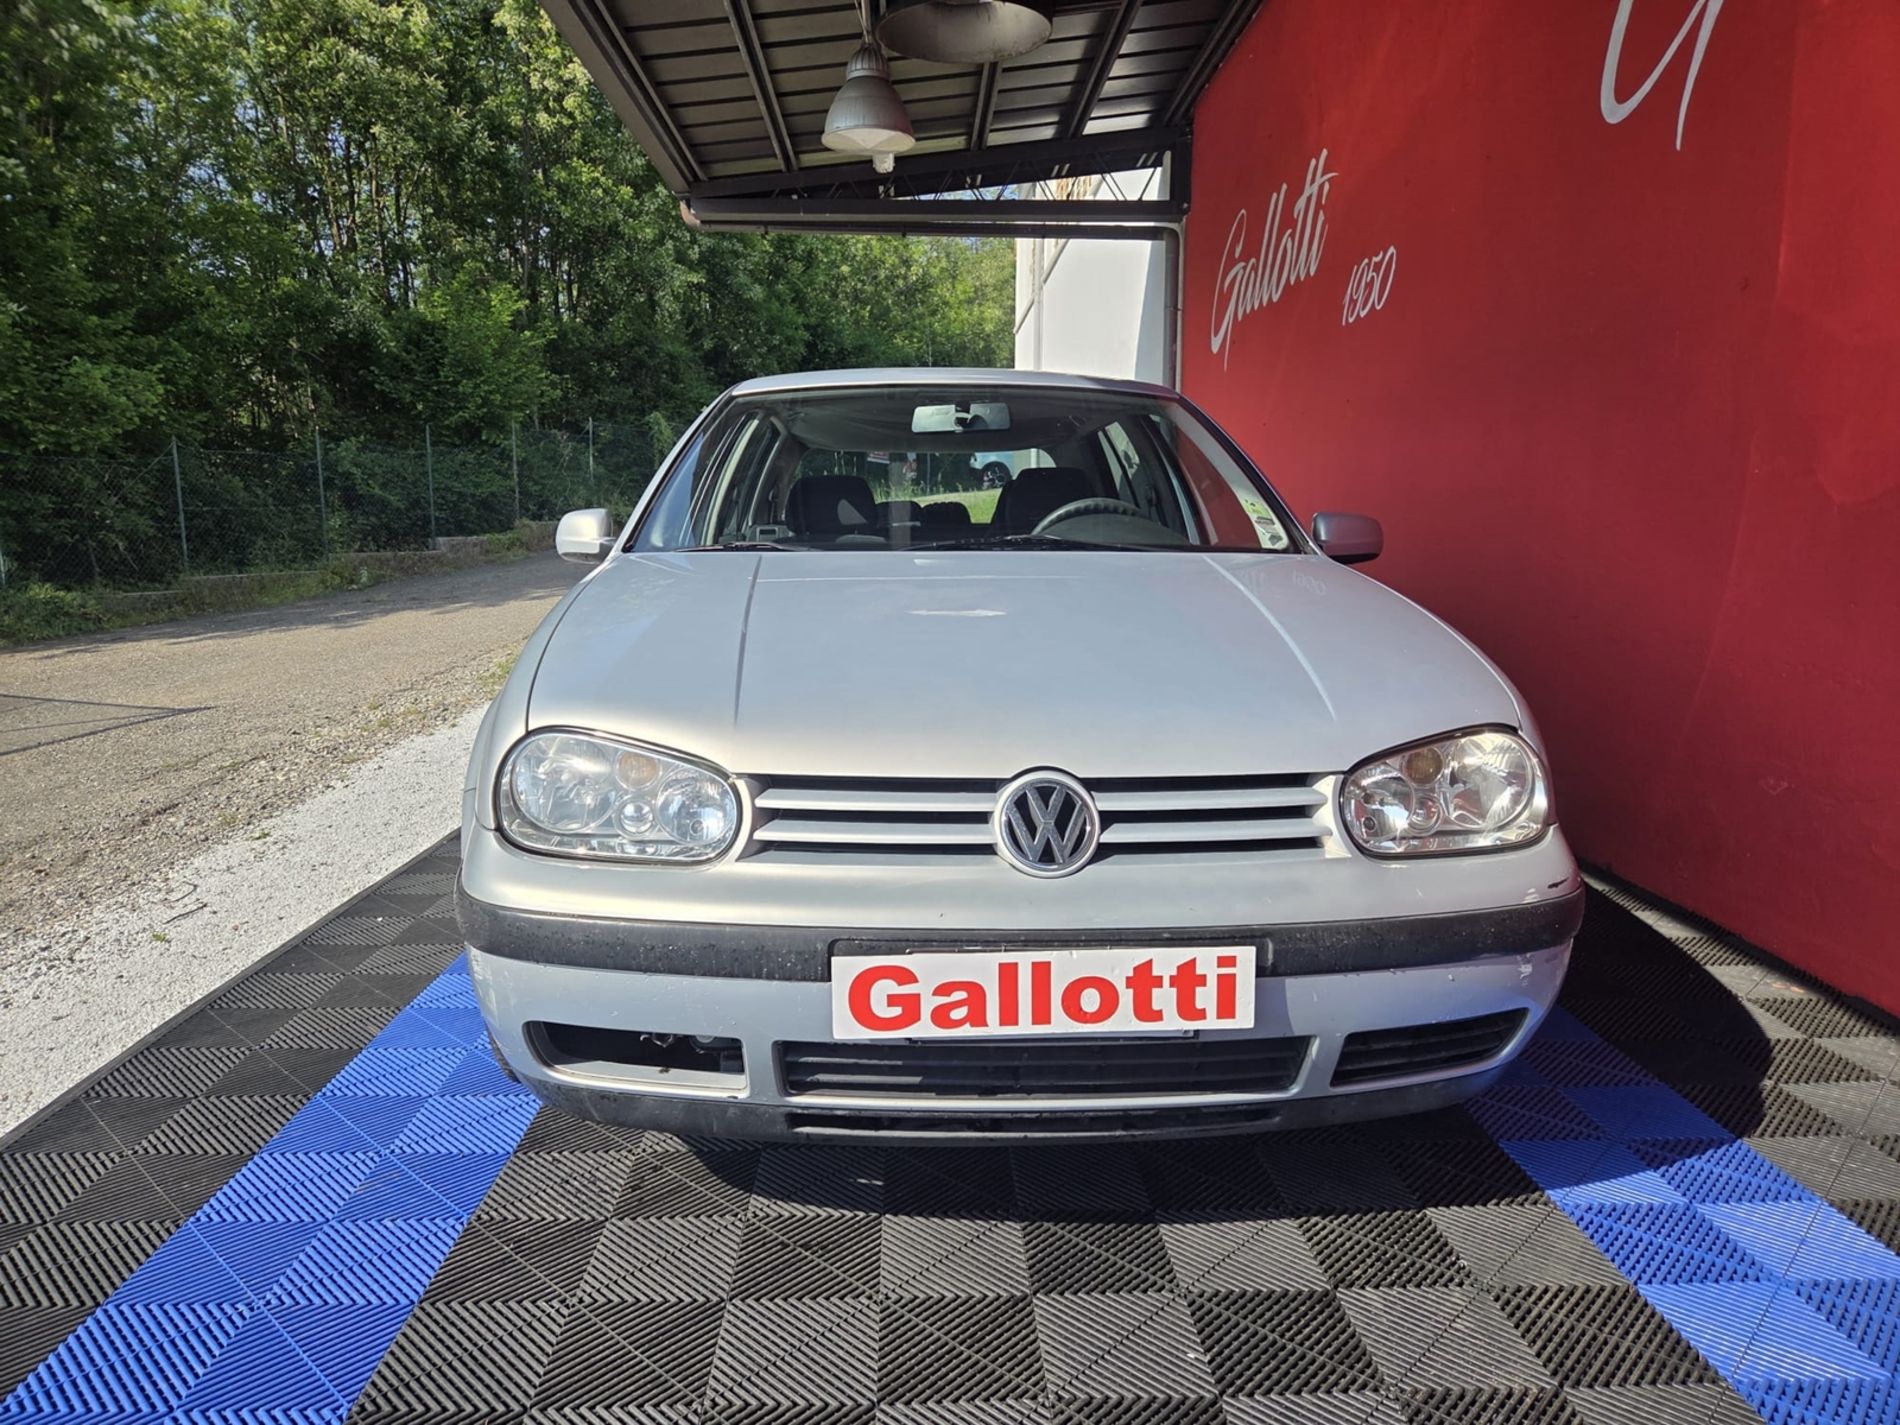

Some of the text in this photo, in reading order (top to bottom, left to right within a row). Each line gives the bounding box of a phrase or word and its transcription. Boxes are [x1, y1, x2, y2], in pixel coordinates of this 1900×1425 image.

[1211, 148, 1339, 372] Gallotti
[1342, 245, 1396, 326] 1950
[1004, 780, 1089, 868] VW
[848, 955, 1237, 1032] Gallotti
